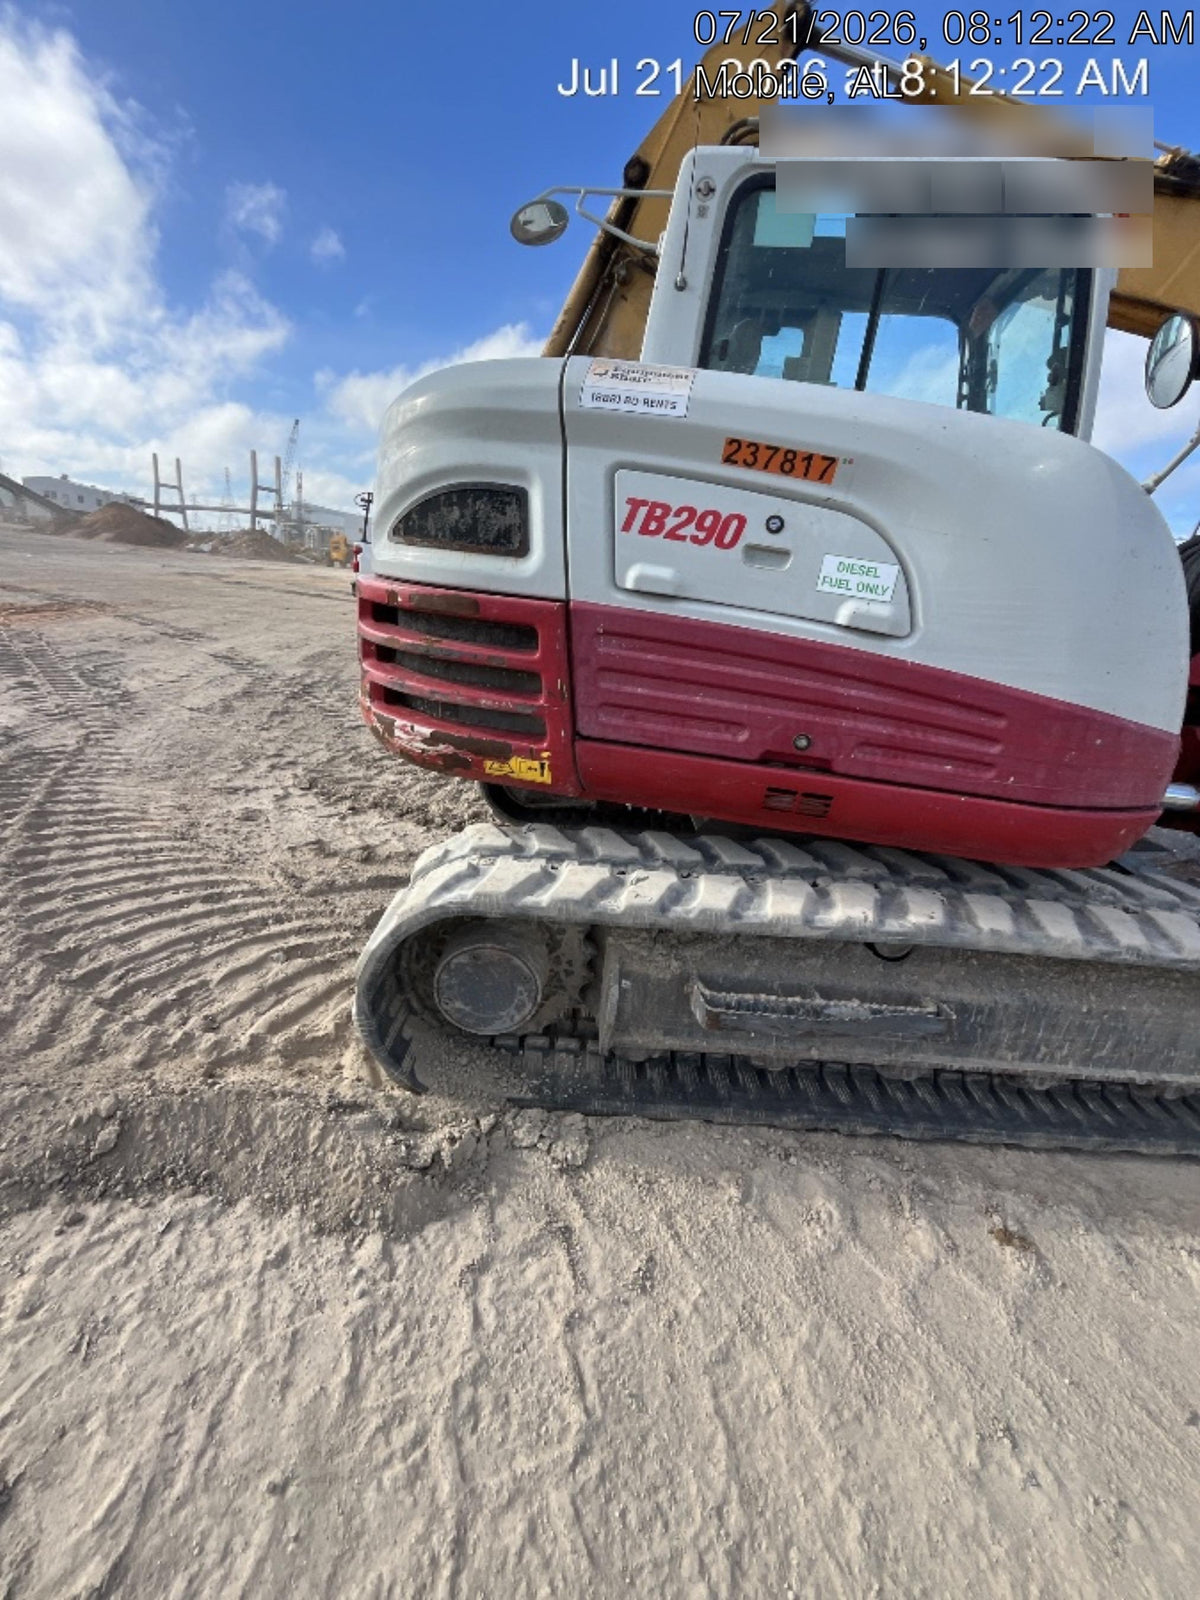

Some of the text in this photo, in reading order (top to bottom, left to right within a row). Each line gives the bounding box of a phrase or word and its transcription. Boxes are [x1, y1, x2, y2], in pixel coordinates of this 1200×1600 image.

[643, 398, 678, 410] RENTS
[723, 438, 837, 483] 237817
[621, 497, 747, 550] TB290
[837, 561, 881, 579] DIESEL
[821, 575, 890, 596] FUEL ONLY
